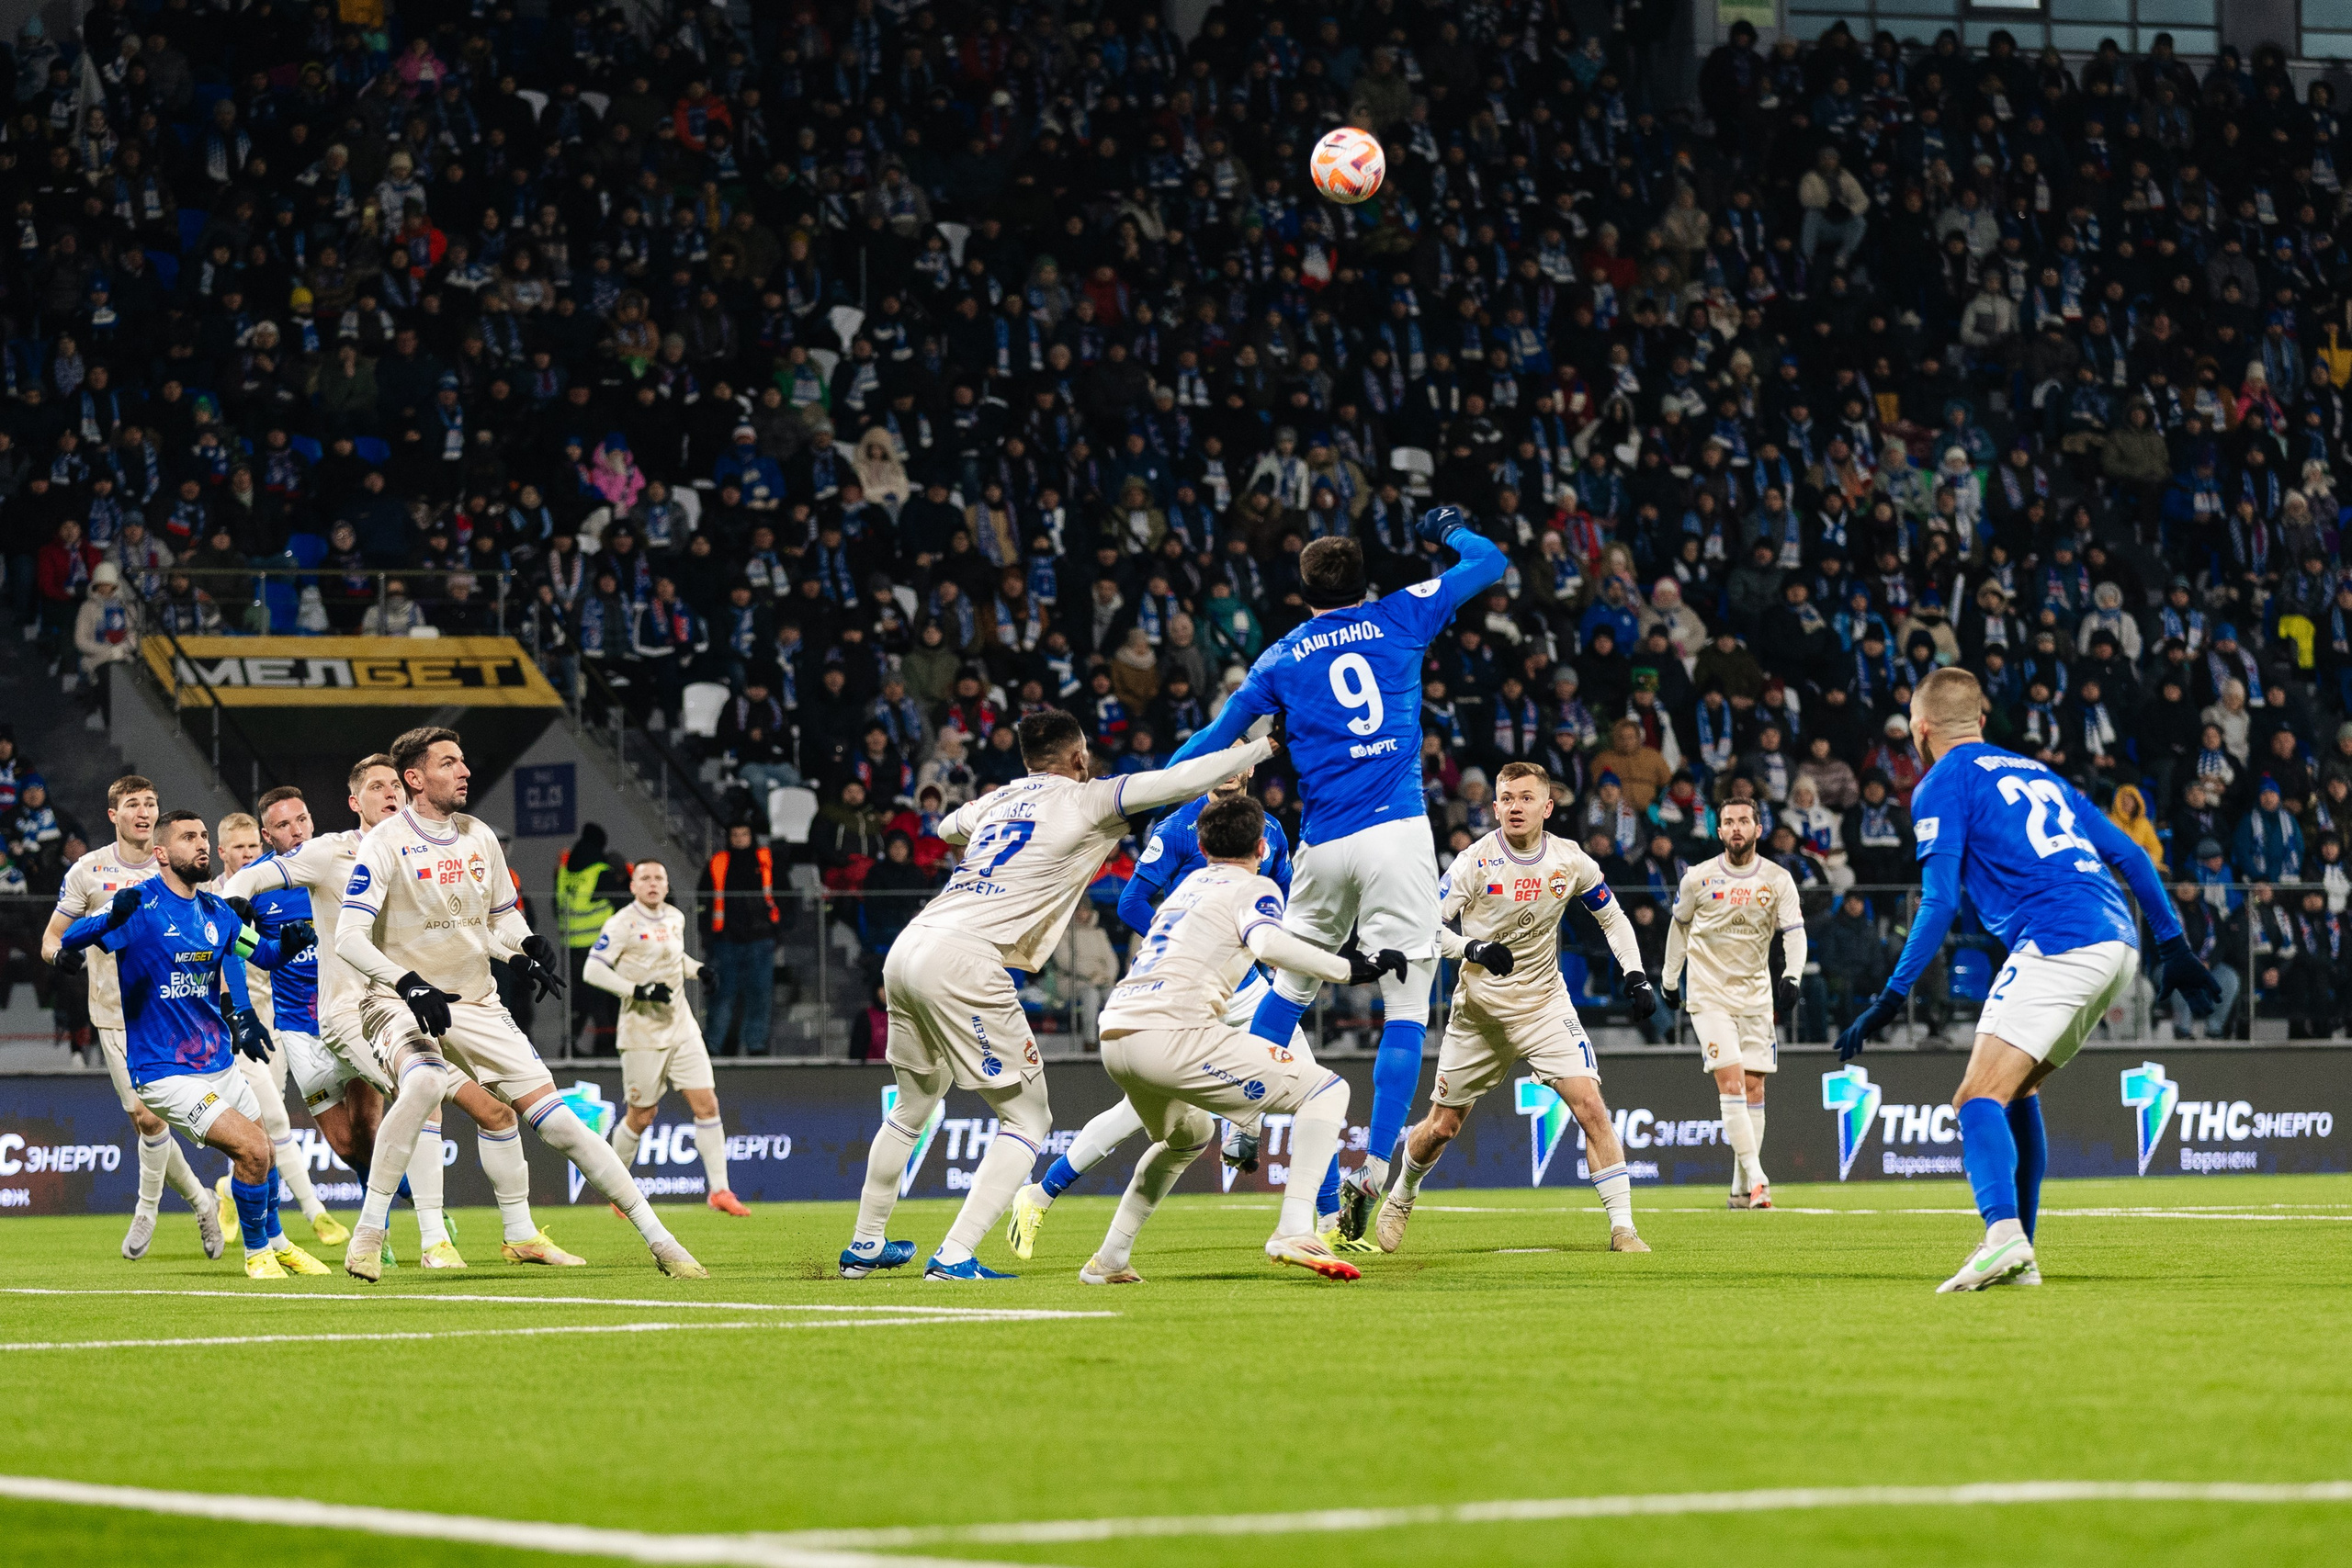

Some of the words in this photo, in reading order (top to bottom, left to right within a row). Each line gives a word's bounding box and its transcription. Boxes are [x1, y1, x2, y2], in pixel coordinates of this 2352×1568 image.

[175, 657, 515, 688] МЕЛБЕТ
[1329, 652, 1385, 736] 9
[1996, 775, 2098, 860] 22
[437, 858, 463, 872] FON
[1488, 857, 1505, 866] ПСБ
[125, 879, 145, 888] FO
[439, 870, 464, 885] BET
[1514, 877, 1542, 890] FON
[1514, 889, 1542, 902] BET
[1730, 887, 1751, 897] FON
[1730, 897, 1751, 906] BET
[424, 917, 482, 931] APOTHEKA
[1493, 927, 1551, 941] APOTHEKA
[175, 951, 213, 964] МЕЛБЕТ
[971, 1015, 993, 1057] РОССЕТИ
[188, 1091, 220, 1124] МЕЛБЕ
[1879, 1104, 1957, 1145] ТНС
[2176, 1100, 2254, 1142] ТНС
[943, 1118, 1001, 1160] ТН
